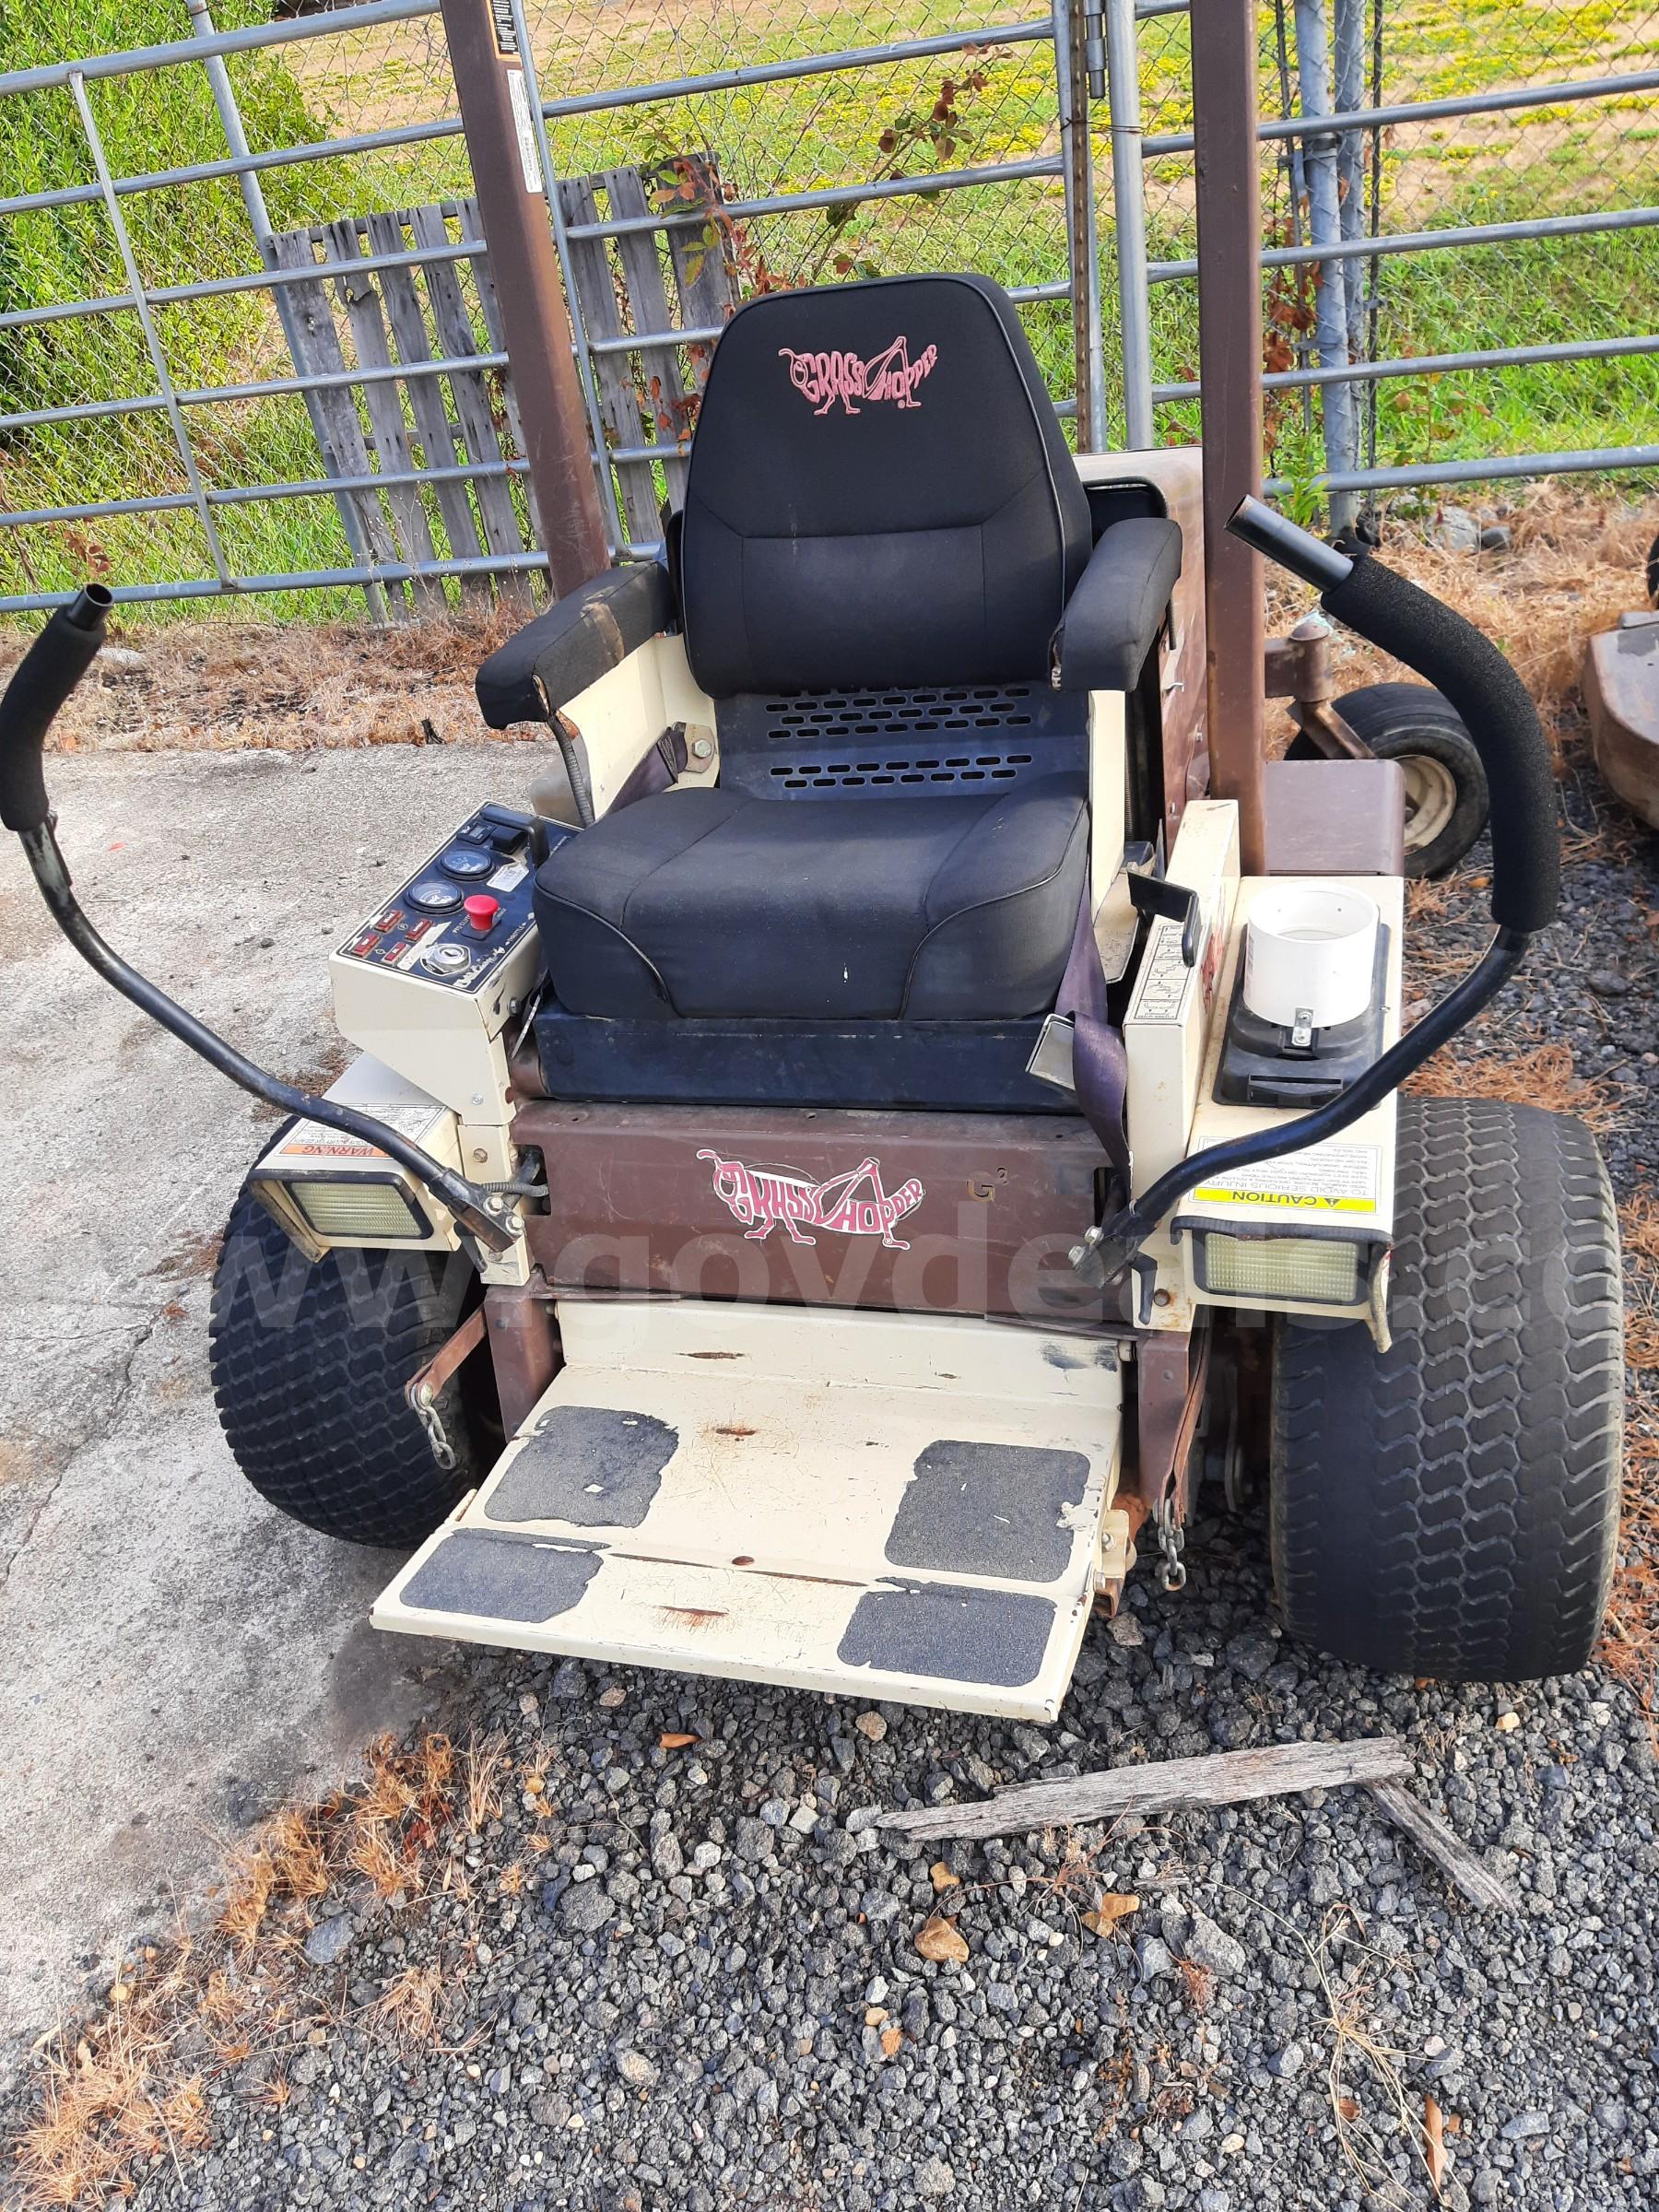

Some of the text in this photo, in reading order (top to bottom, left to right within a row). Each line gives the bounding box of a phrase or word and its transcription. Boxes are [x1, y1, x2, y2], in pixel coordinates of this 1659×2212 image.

[302, 1146, 374, 1156] WARNING
[1206, 1180, 1369, 1196] TO AVOID SERIOUS INJURY
[1232, 1190, 1317, 1206] CAUTION
